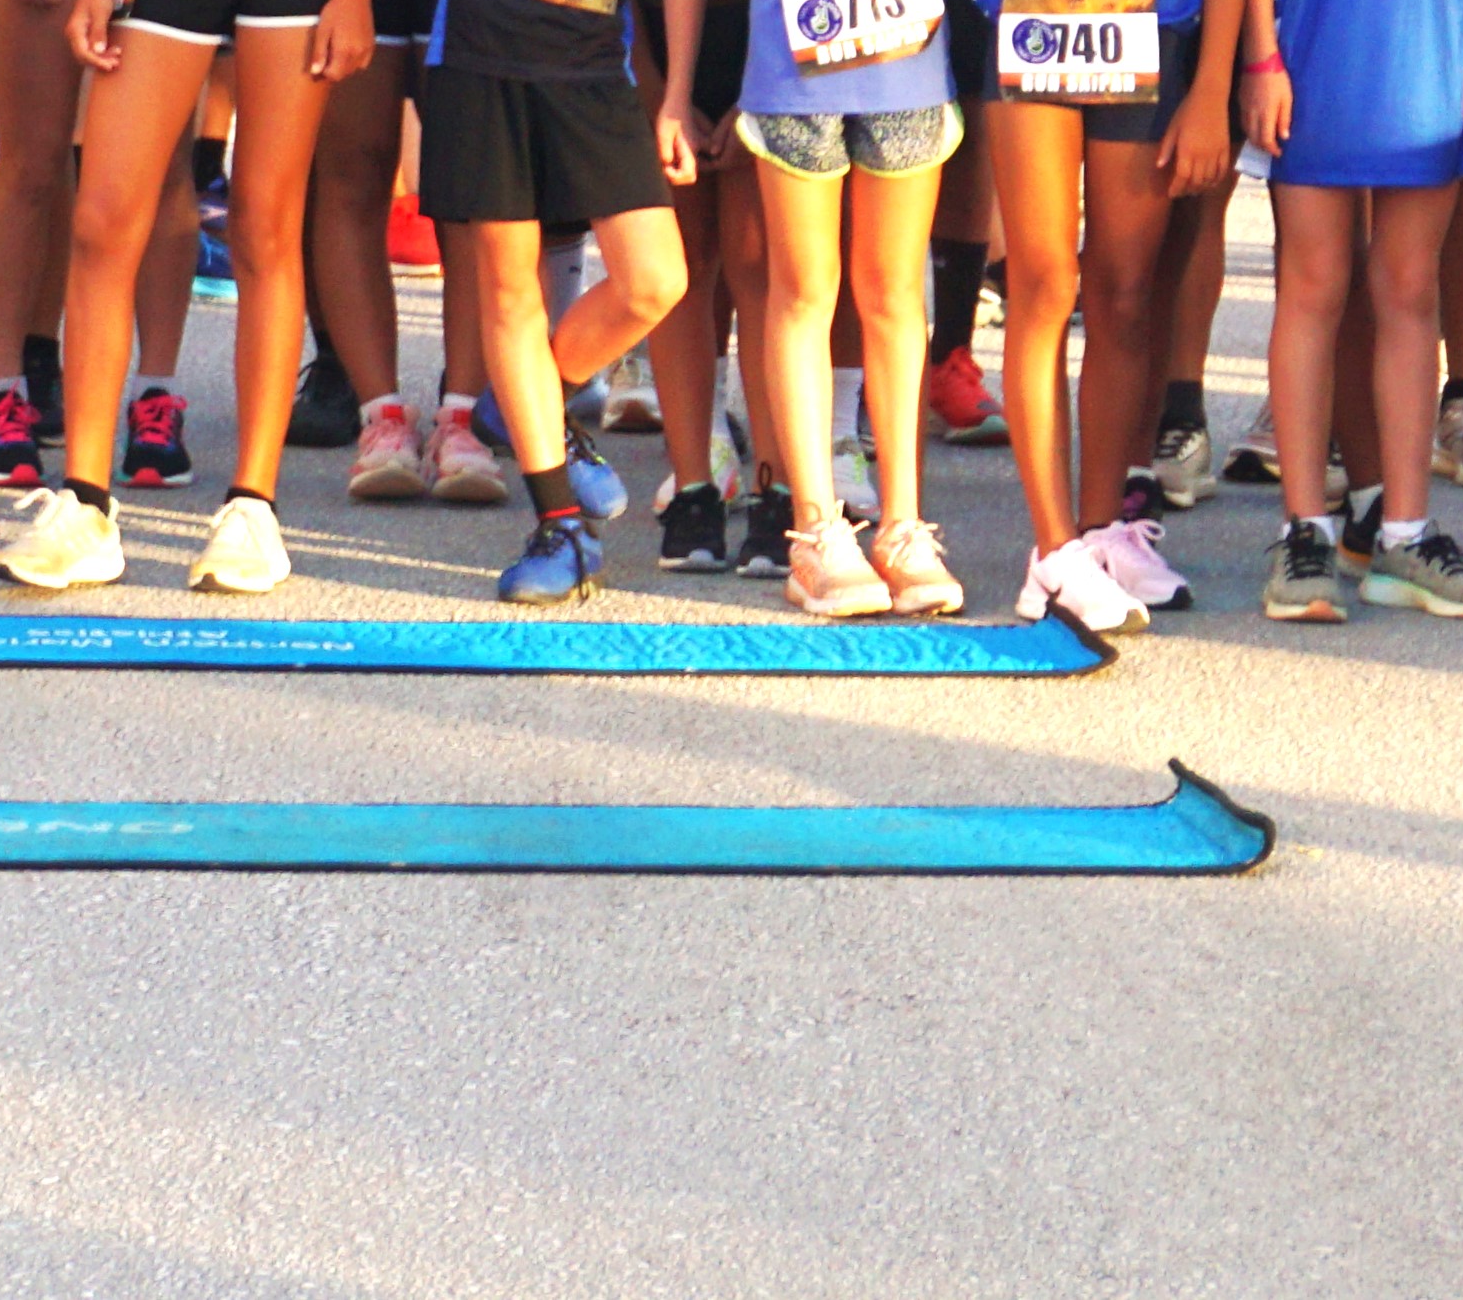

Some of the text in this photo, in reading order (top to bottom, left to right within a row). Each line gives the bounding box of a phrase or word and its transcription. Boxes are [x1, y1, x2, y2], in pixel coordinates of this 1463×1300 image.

[815, 38, 857, 66] RUN
[1051, 21, 1123, 64] 740
[1021, 73, 1136, 93] RUN SAIPAN
